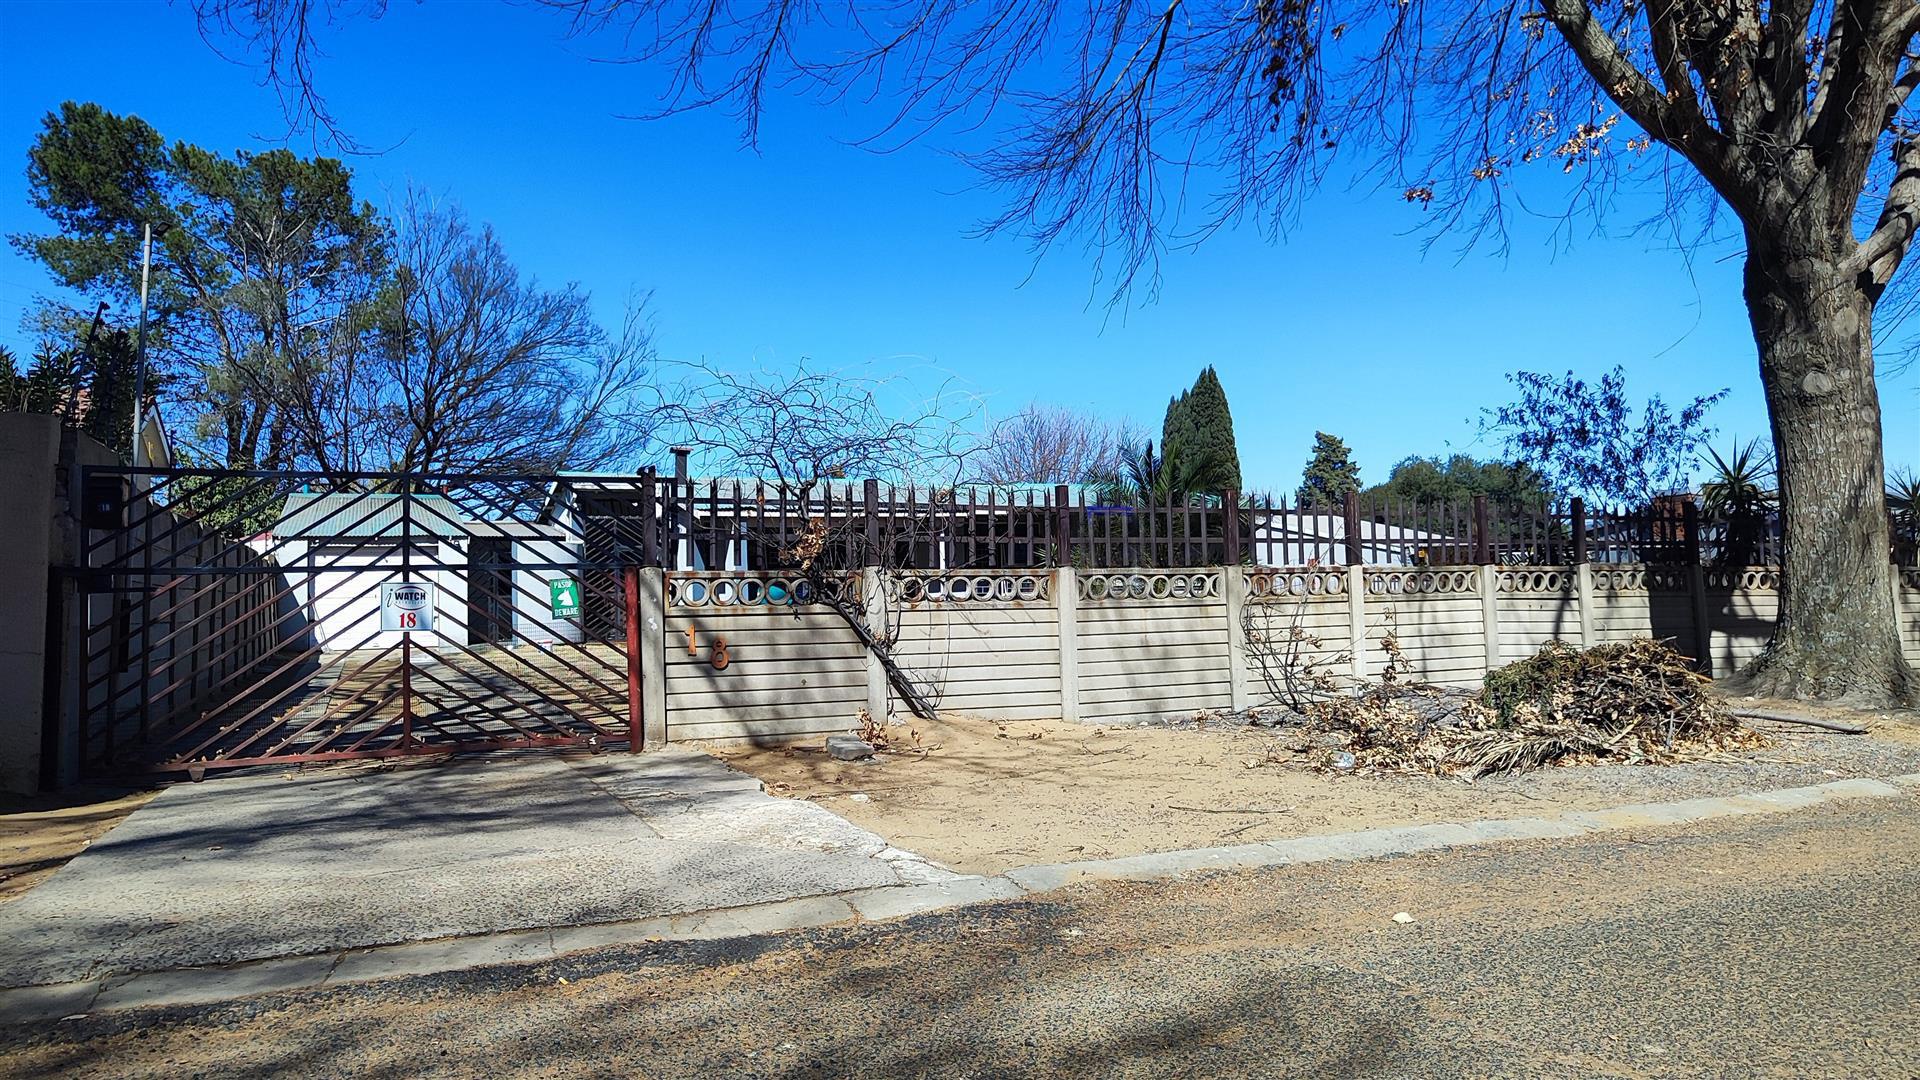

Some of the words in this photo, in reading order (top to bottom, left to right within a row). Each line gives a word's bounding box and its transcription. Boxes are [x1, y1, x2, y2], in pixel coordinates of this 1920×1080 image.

[553, 581, 573, 589] PASOP
[554, 607, 579, 617] BEWARE
[399, 612, 417, 628] 18
